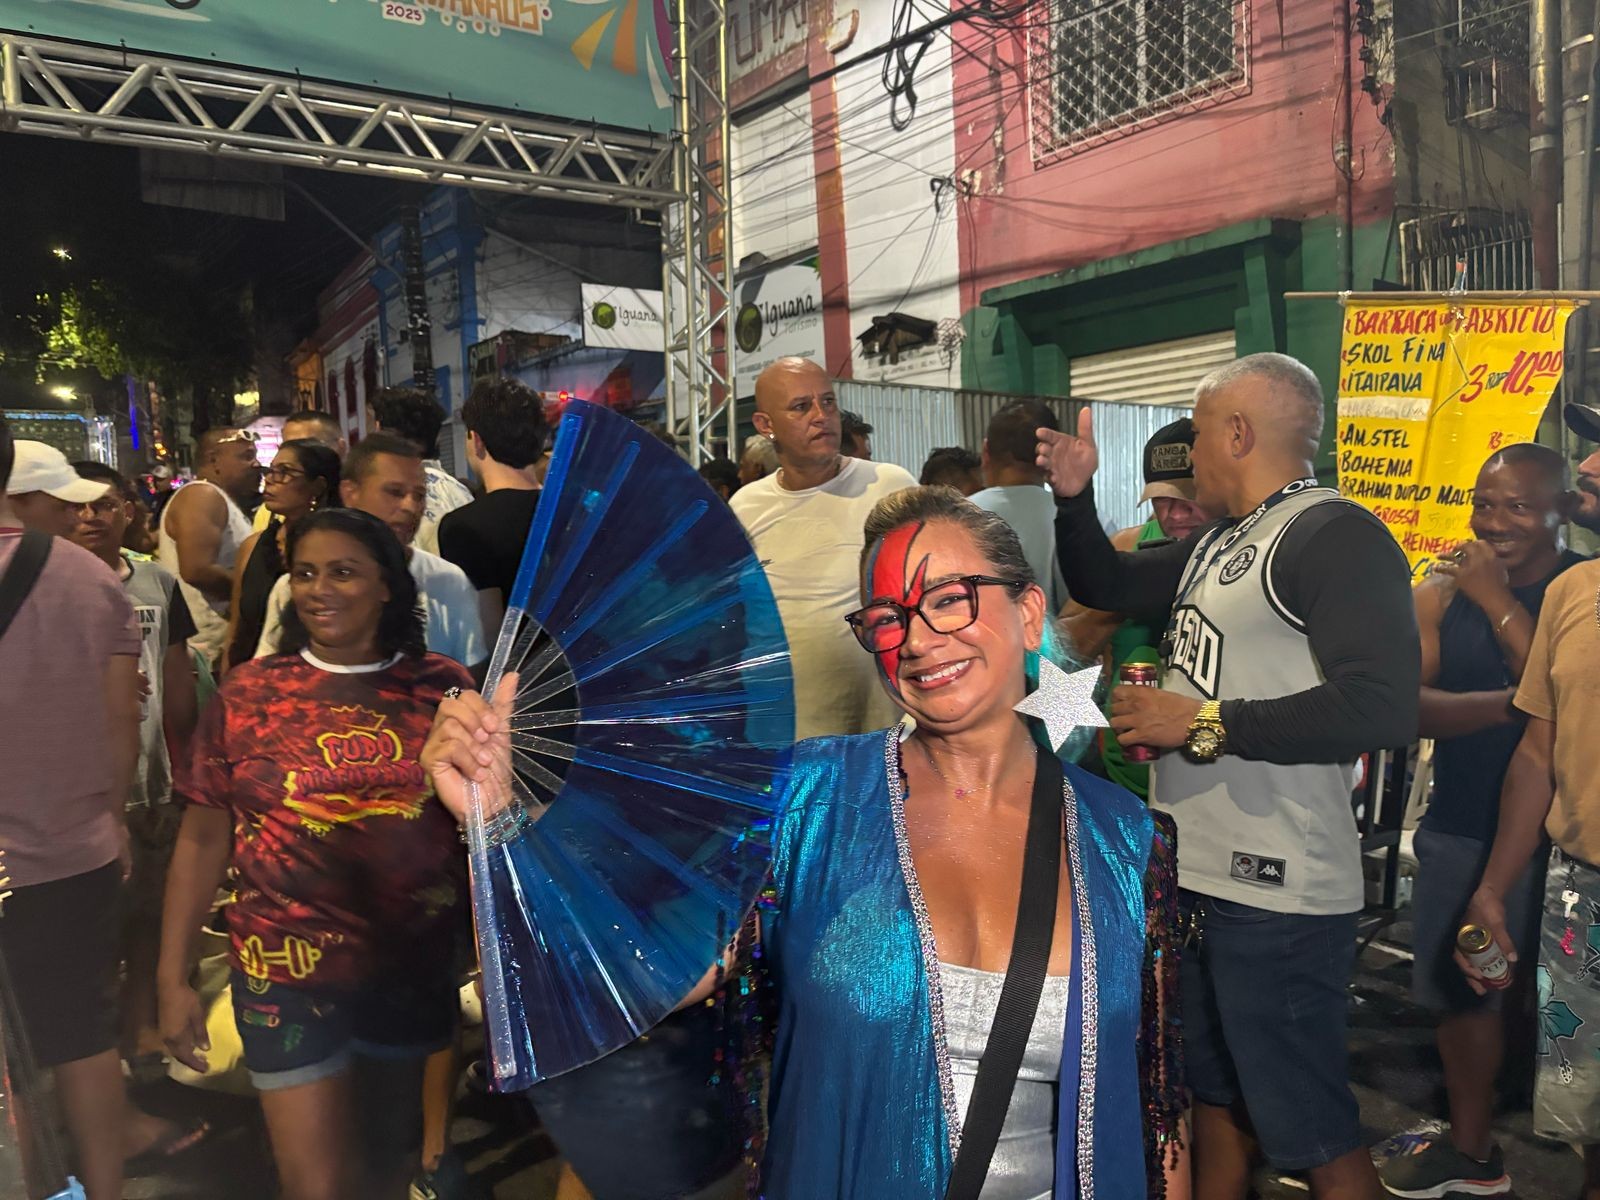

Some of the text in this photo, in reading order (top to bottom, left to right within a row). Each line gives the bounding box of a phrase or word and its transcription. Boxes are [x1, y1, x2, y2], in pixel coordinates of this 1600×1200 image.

[385, 4, 423, 22] 2025
[619, 306, 657, 326] Iguana
[764, 294, 816, 336] Iguana
[1354, 309, 1437, 336] BARRACA
[1347, 342, 1393, 366] SKOL
[1460, 363, 1488, 403] 3
[1343, 423, 1410, 448] AMSTEL
[1341, 449, 1413, 477] BOHEMIA
[1341, 476, 1391, 498] BRAHMA
[324, 733, 393, 760] TUDO
